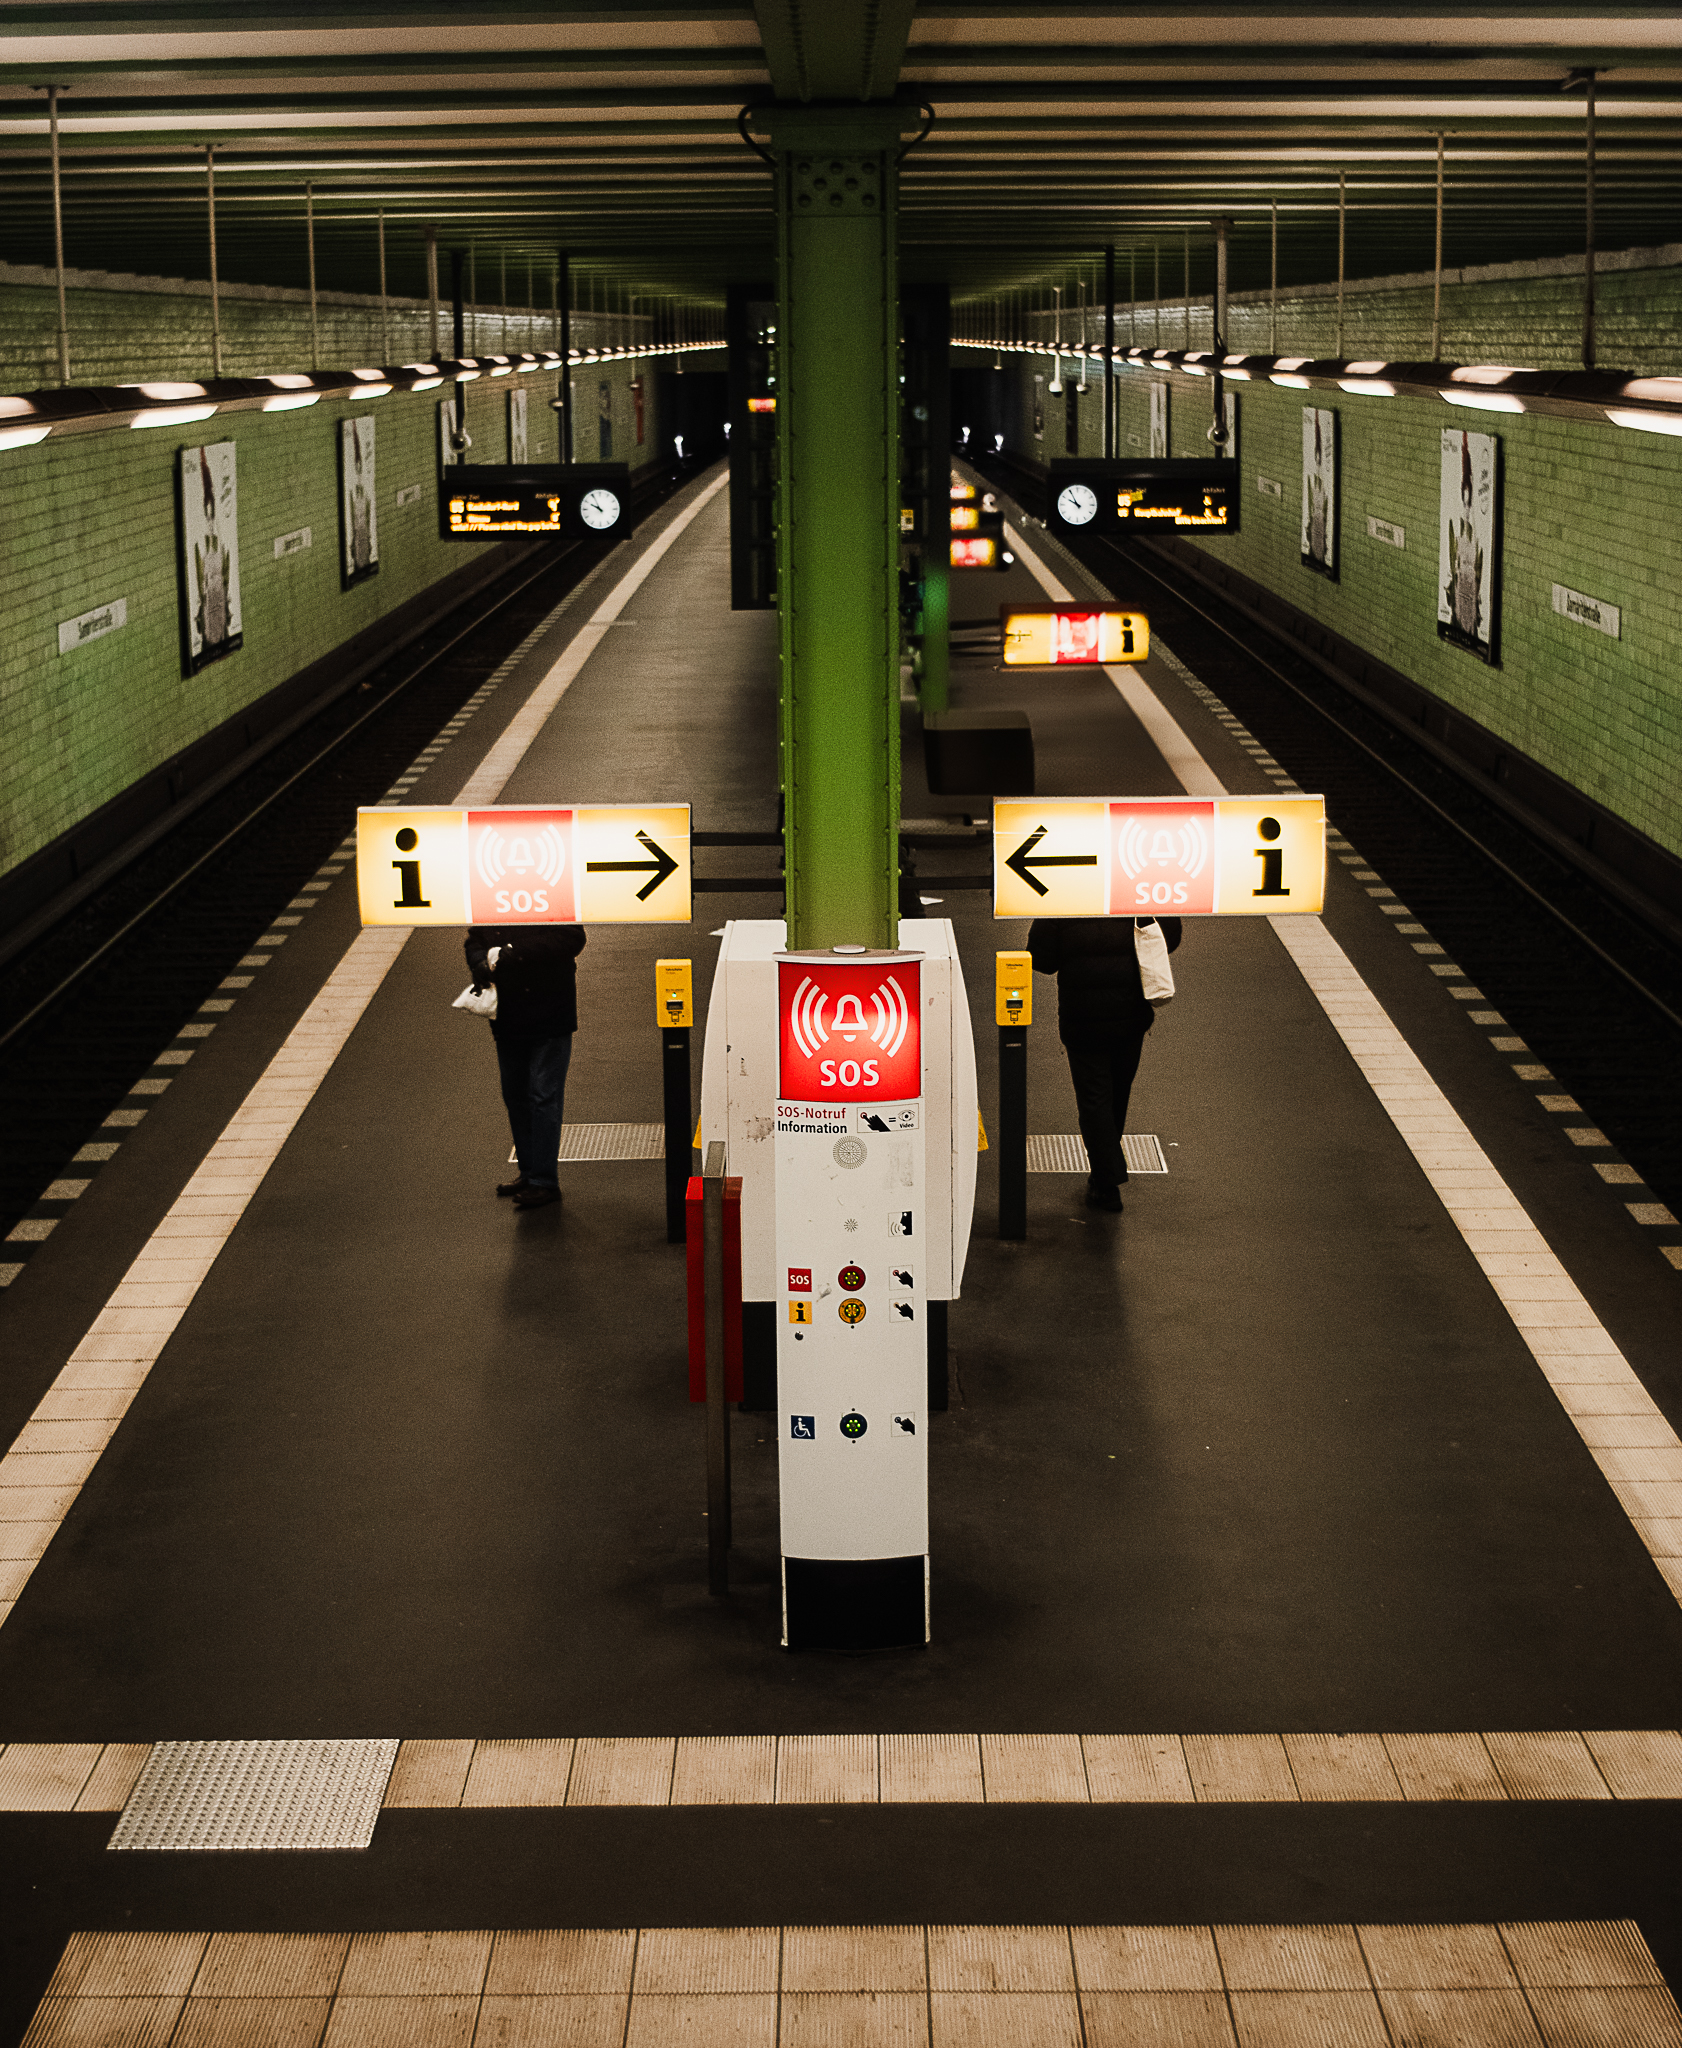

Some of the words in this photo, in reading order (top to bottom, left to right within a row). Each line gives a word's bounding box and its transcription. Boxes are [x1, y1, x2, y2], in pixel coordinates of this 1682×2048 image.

[495, 890, 549, 913] SOS
[1135, 881, 1188, 905] SOS
[820, 1059, 880, 1087] SOS
[777, 1106, 847, 1119] SOS-Notruf
[777, 1120, 848, 1134] Information
[790, 1274, 810, 1285] SOS
